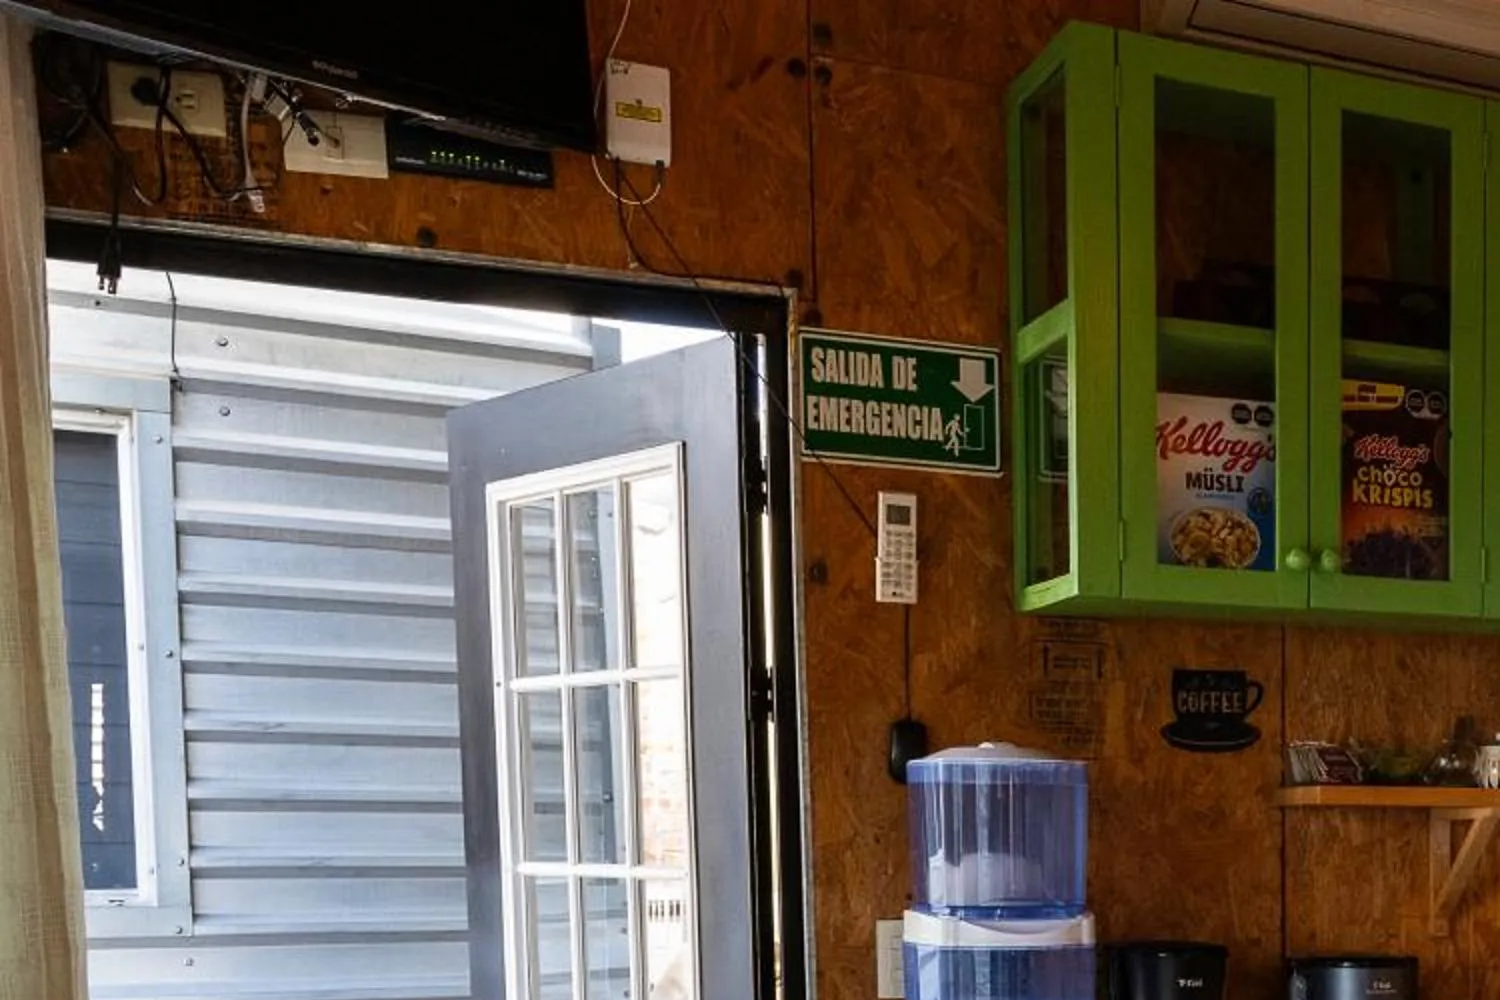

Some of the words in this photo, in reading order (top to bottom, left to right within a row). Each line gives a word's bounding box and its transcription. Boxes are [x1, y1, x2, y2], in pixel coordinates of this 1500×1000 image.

[811, 347, 885, 389] SALIDA
[892, 355, 918, 392] DE
[807, 395, 945, 443] EMERGENCIA
[1185, 468, 1245, 493] MÜSLI
[1352, 479, 1434, 508] KRISPIS
[1178, 690, 1244, 714] COFFEE
